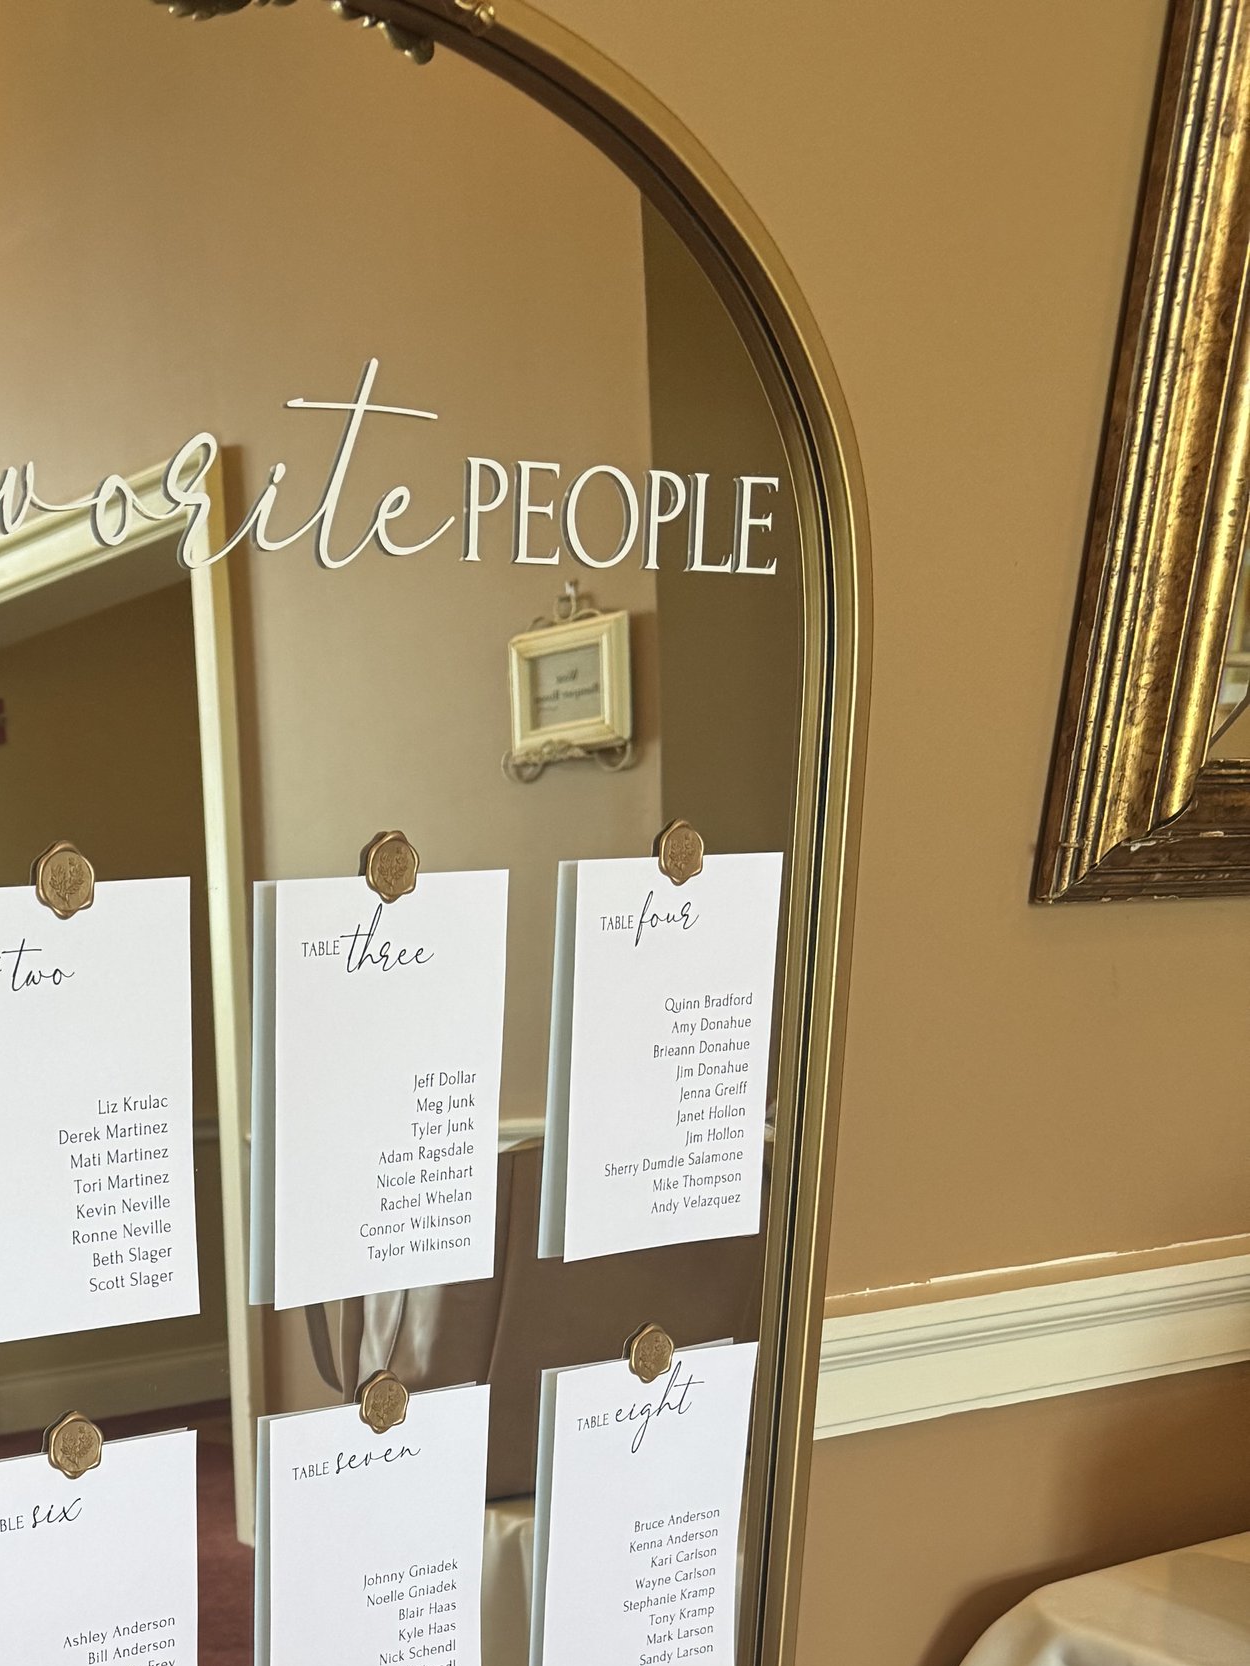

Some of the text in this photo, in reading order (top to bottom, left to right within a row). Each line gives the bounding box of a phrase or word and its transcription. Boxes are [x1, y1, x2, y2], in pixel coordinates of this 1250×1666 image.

[462, 457, 779, 575] PEOPLE
[600, 890, 699, 947] TABLE four
[301, 903, 434, 973] TABLE three
[2, 938, 75, 992] two
[665, 992, 752, 1013] Quinn Bradford
[672, 1016, 751, 1035] Amy Donahue
[676, 1060, 748, 1081] Jim Donahue
[413, 1071, 476, 1093] Jeff Dollar
[99, 1095, 168, 1114] Liz Krulac
[417, 1094, 475, 1114] Meg Junk
[676, 1105, 745, 1127] Janet Hollon
[59, 1123, 168, 1144] Derek Martinez
[379, 1141, 473, 1165] Adam Ragsdale
[74, 1174, 169, 1194] Tori Martinez
[653, 1173, 741, 1192] Mike Thompson
[77, 1195, 170, 1219] Kevin Neville
[381, 1189, 471, 1211] Rachel Whelan
[651, 1194, 740, 1214] Andy Velazquez
[360, 1215, 471, 1237] Connor Wilkinson
[93, 1247, 172, 1267] Beth Slager
[577, 1361, 704, 1453] TABLE eight
[292, 1446, 421, 1480] TABLE seven
[32, 1498, 82, 1528] six
[635, 1510, 719, 1532] Bruce Anderson
[363, 1559, 458, 1591] Johnny Gniadek
[636, 1568, 715, 1590] Wayne Carlson
[399, 1602, 456, 1620] Blair Haas
[649, 1606, 714, 1625] Tony Kramp
[64, 1617, 175, 1648] Ashley Anderson
[399, 1622, 456, 1643] Kyle Haas
[647, 1625, 713, 1645] Mark Larson
[380, 1639, 455, 1666] Nick Schendl
[640, 1645, 713, 1666] Sandy Larson
